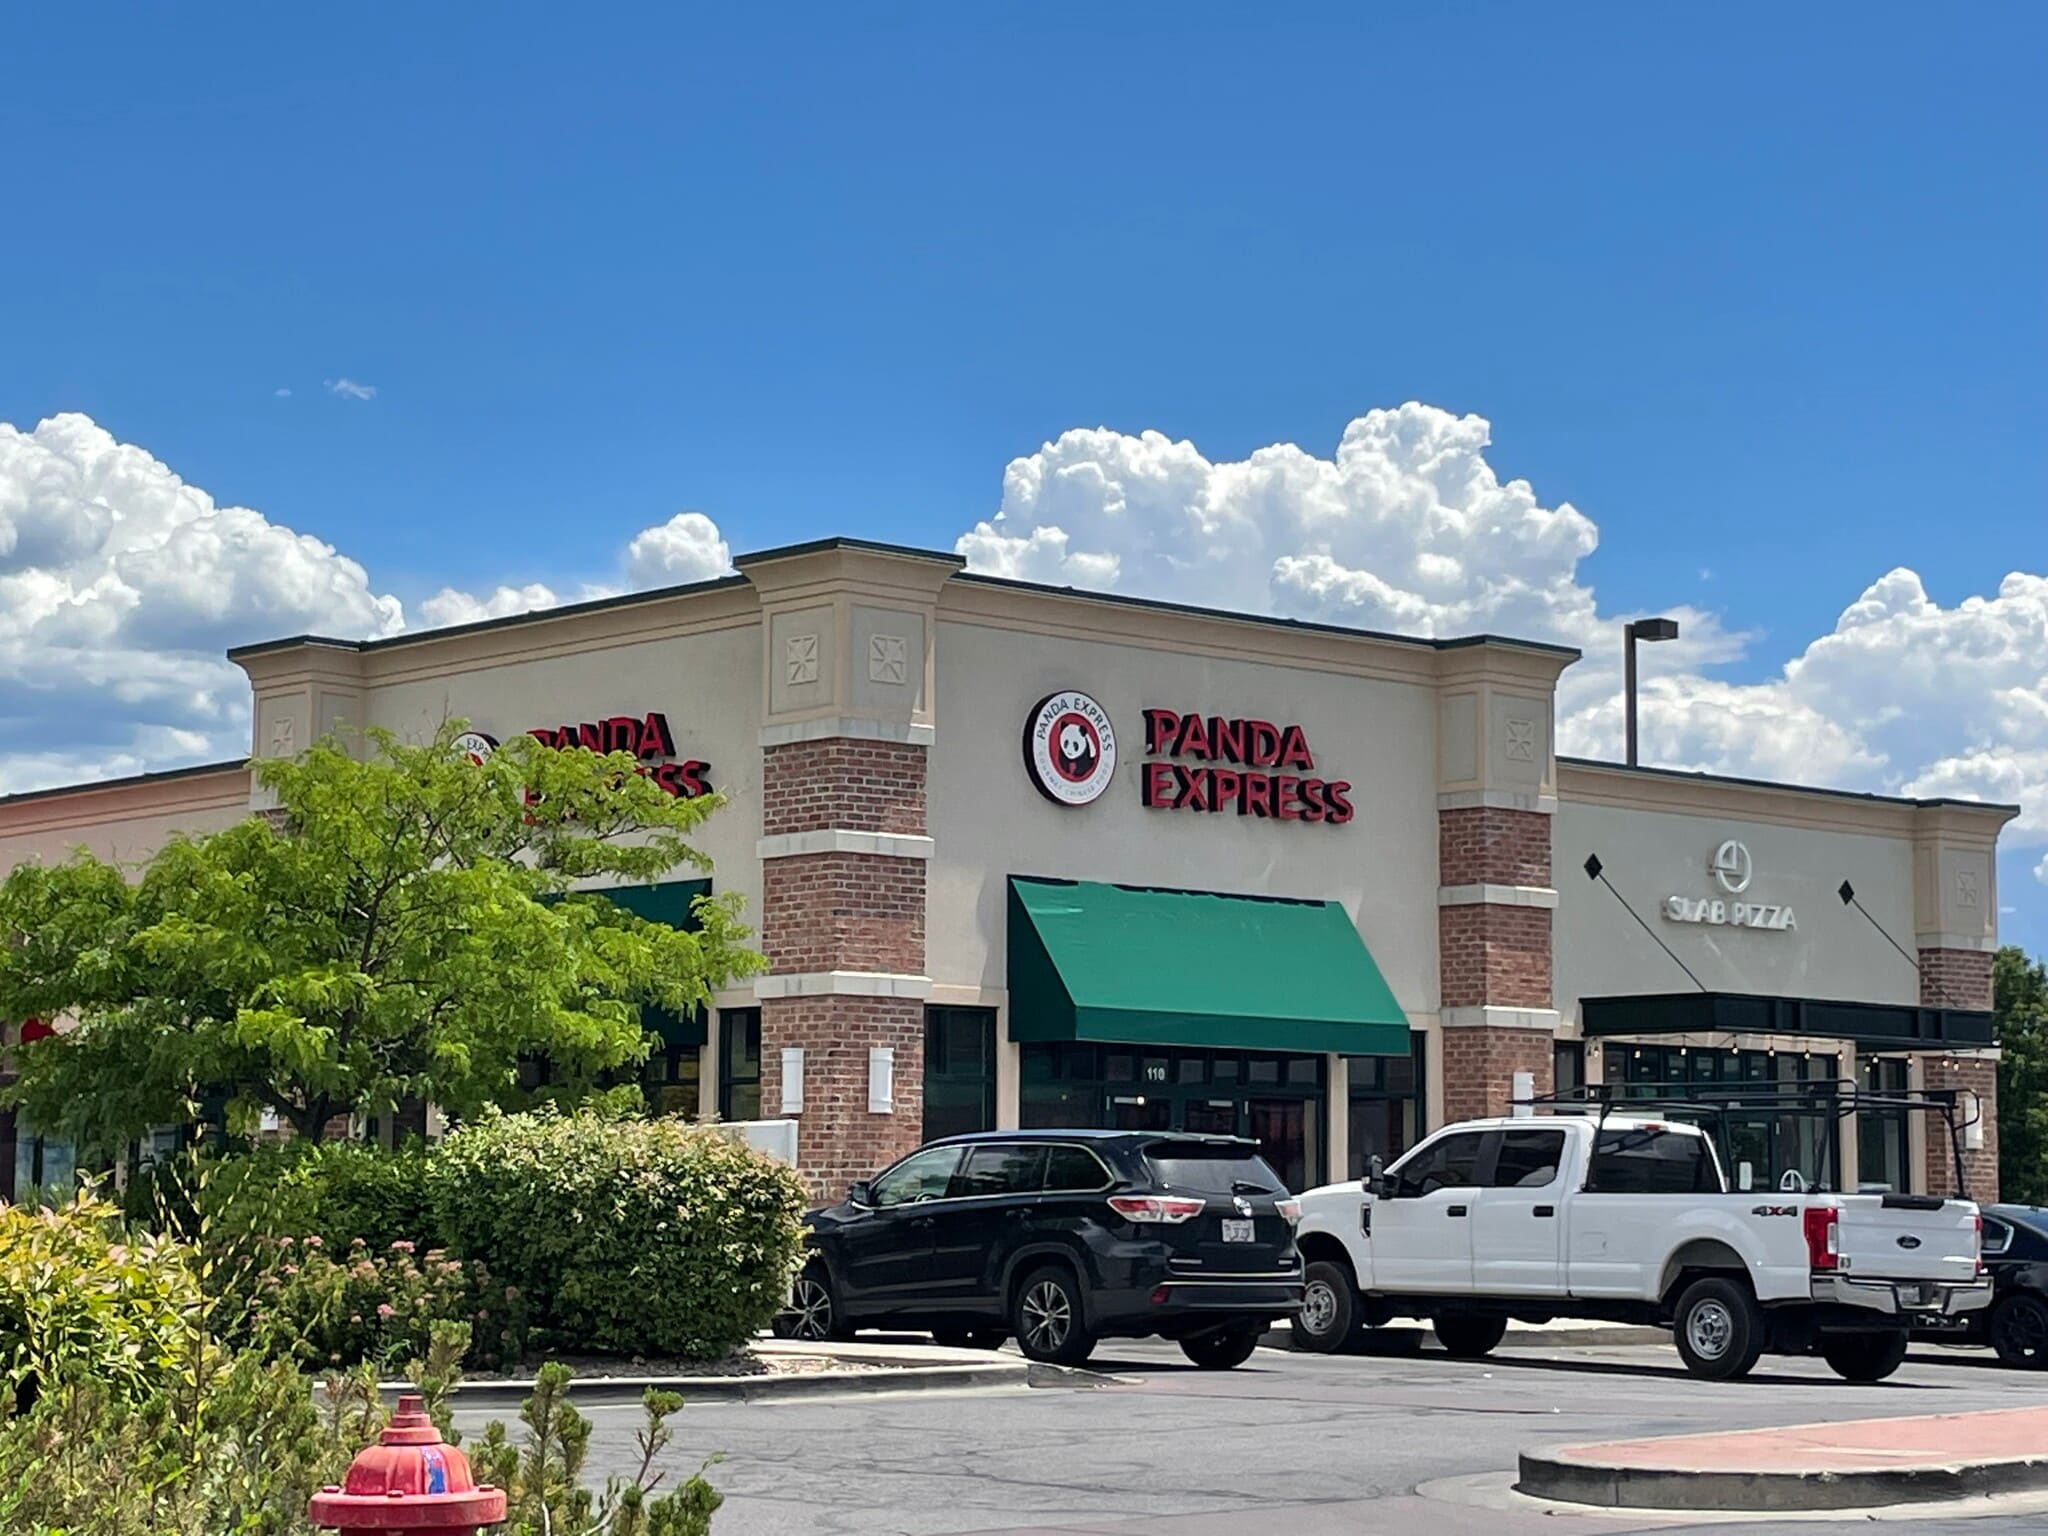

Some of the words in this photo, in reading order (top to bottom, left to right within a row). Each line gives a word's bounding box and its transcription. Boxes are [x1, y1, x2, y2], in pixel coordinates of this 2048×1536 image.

[1037, 698, 1069, 740] PANDA
[1073, 698, 1112, 752] EXPRESS
[1142, 709, 1314, 771] PANDA
[1142, 762, 1354, 824] EXPRESS
[1667, 895, 1725, 925] SLAB
[1731, 901, 1798, 931] PIZZA
[1147, 1066, 1165, 1081] 110
